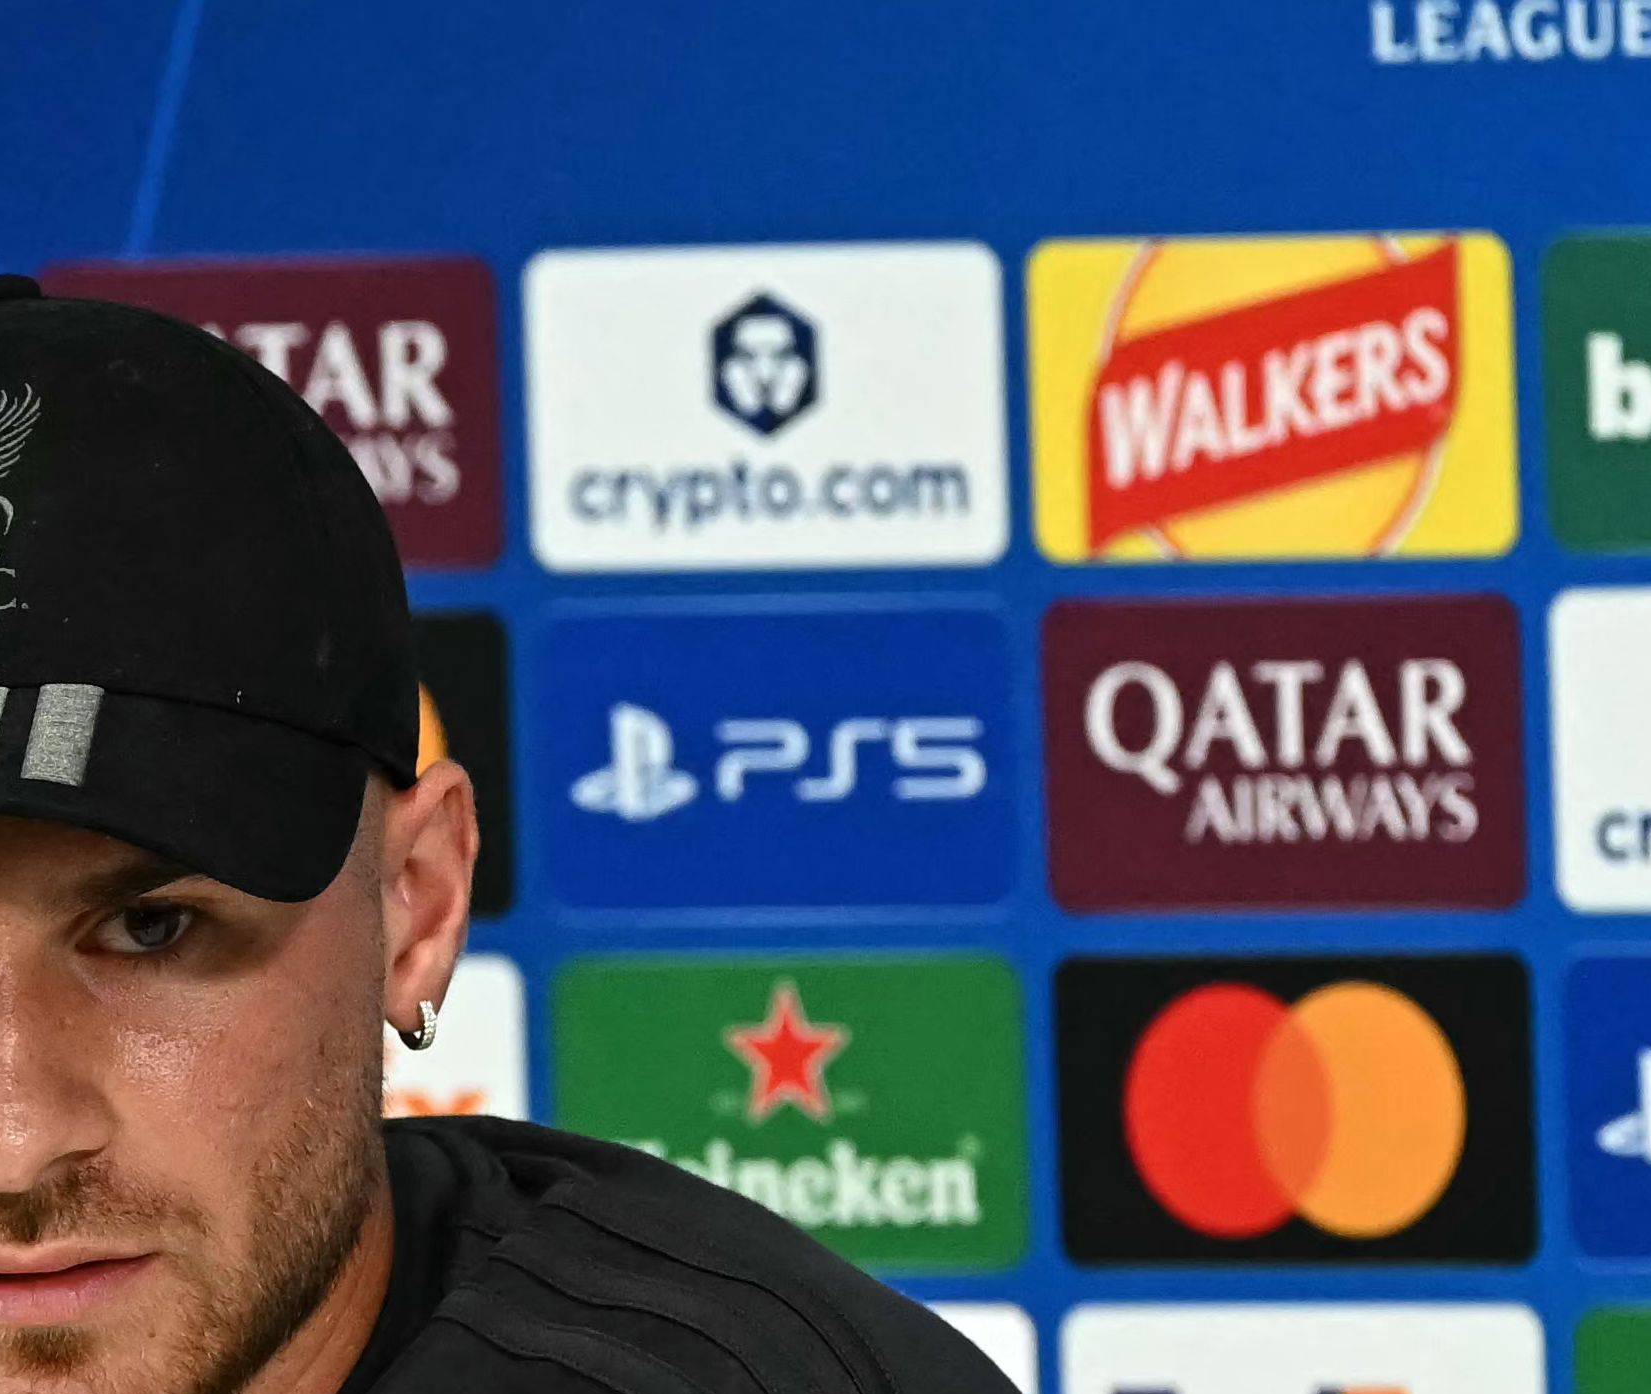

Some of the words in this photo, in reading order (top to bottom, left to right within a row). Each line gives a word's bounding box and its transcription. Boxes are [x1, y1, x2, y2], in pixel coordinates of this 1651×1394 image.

[200, 321, 456, 430] TAR
[1098, 307, 1449, 489] WALKERS
[569, 459, 971, 534] crypto.com
[714, 718, 987, 801] PS5
[1084, 658, 1473, 796] QATAR
[1184, 772, 1480, 844] AIRWAYS
